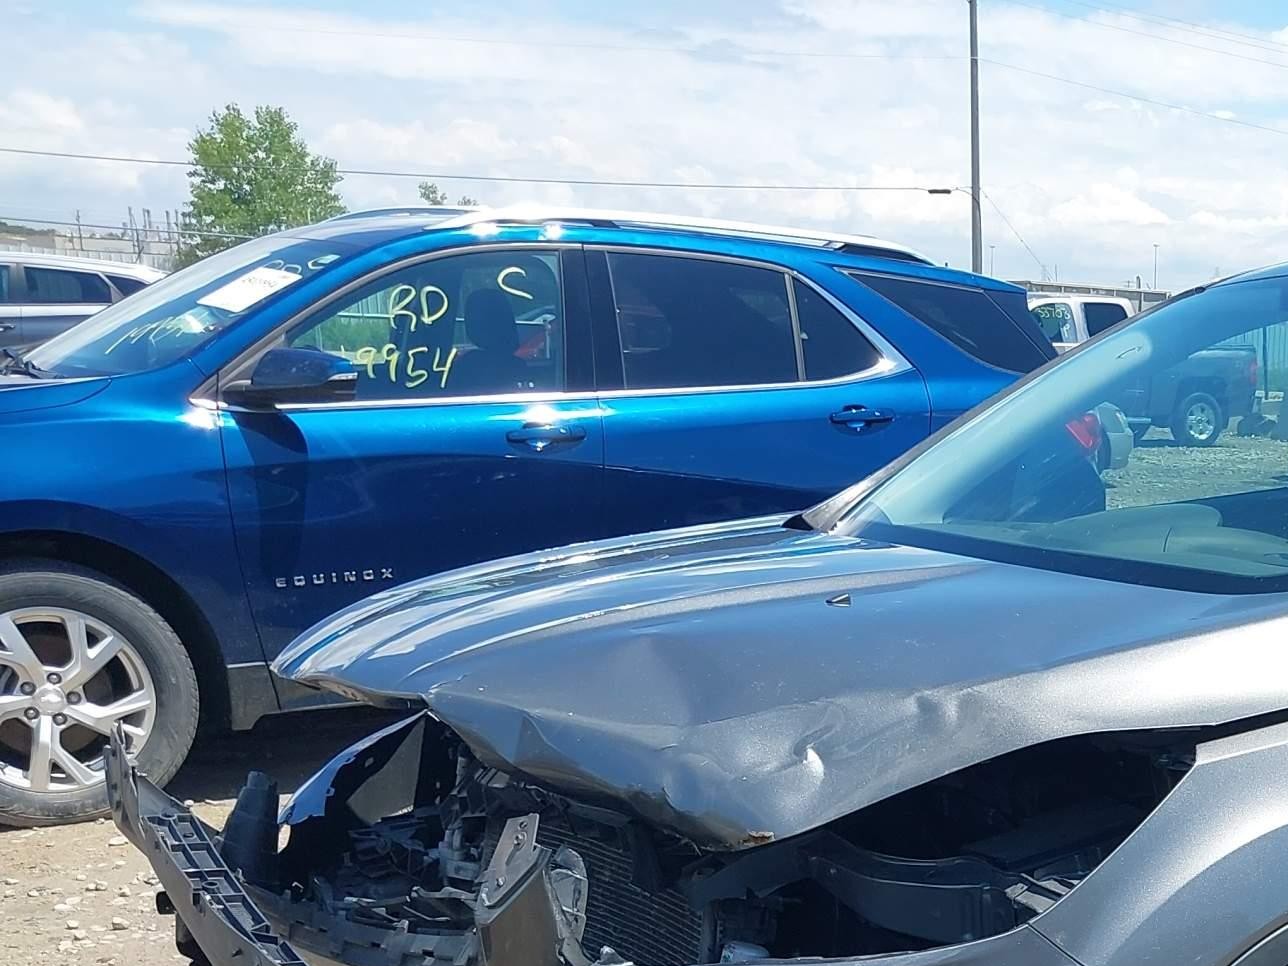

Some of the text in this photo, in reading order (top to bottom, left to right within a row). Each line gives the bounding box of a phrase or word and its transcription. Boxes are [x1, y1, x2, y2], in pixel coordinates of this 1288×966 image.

[388, 266, 534, 332] RD C
[275, 568, 393, 588] EQUINOX
